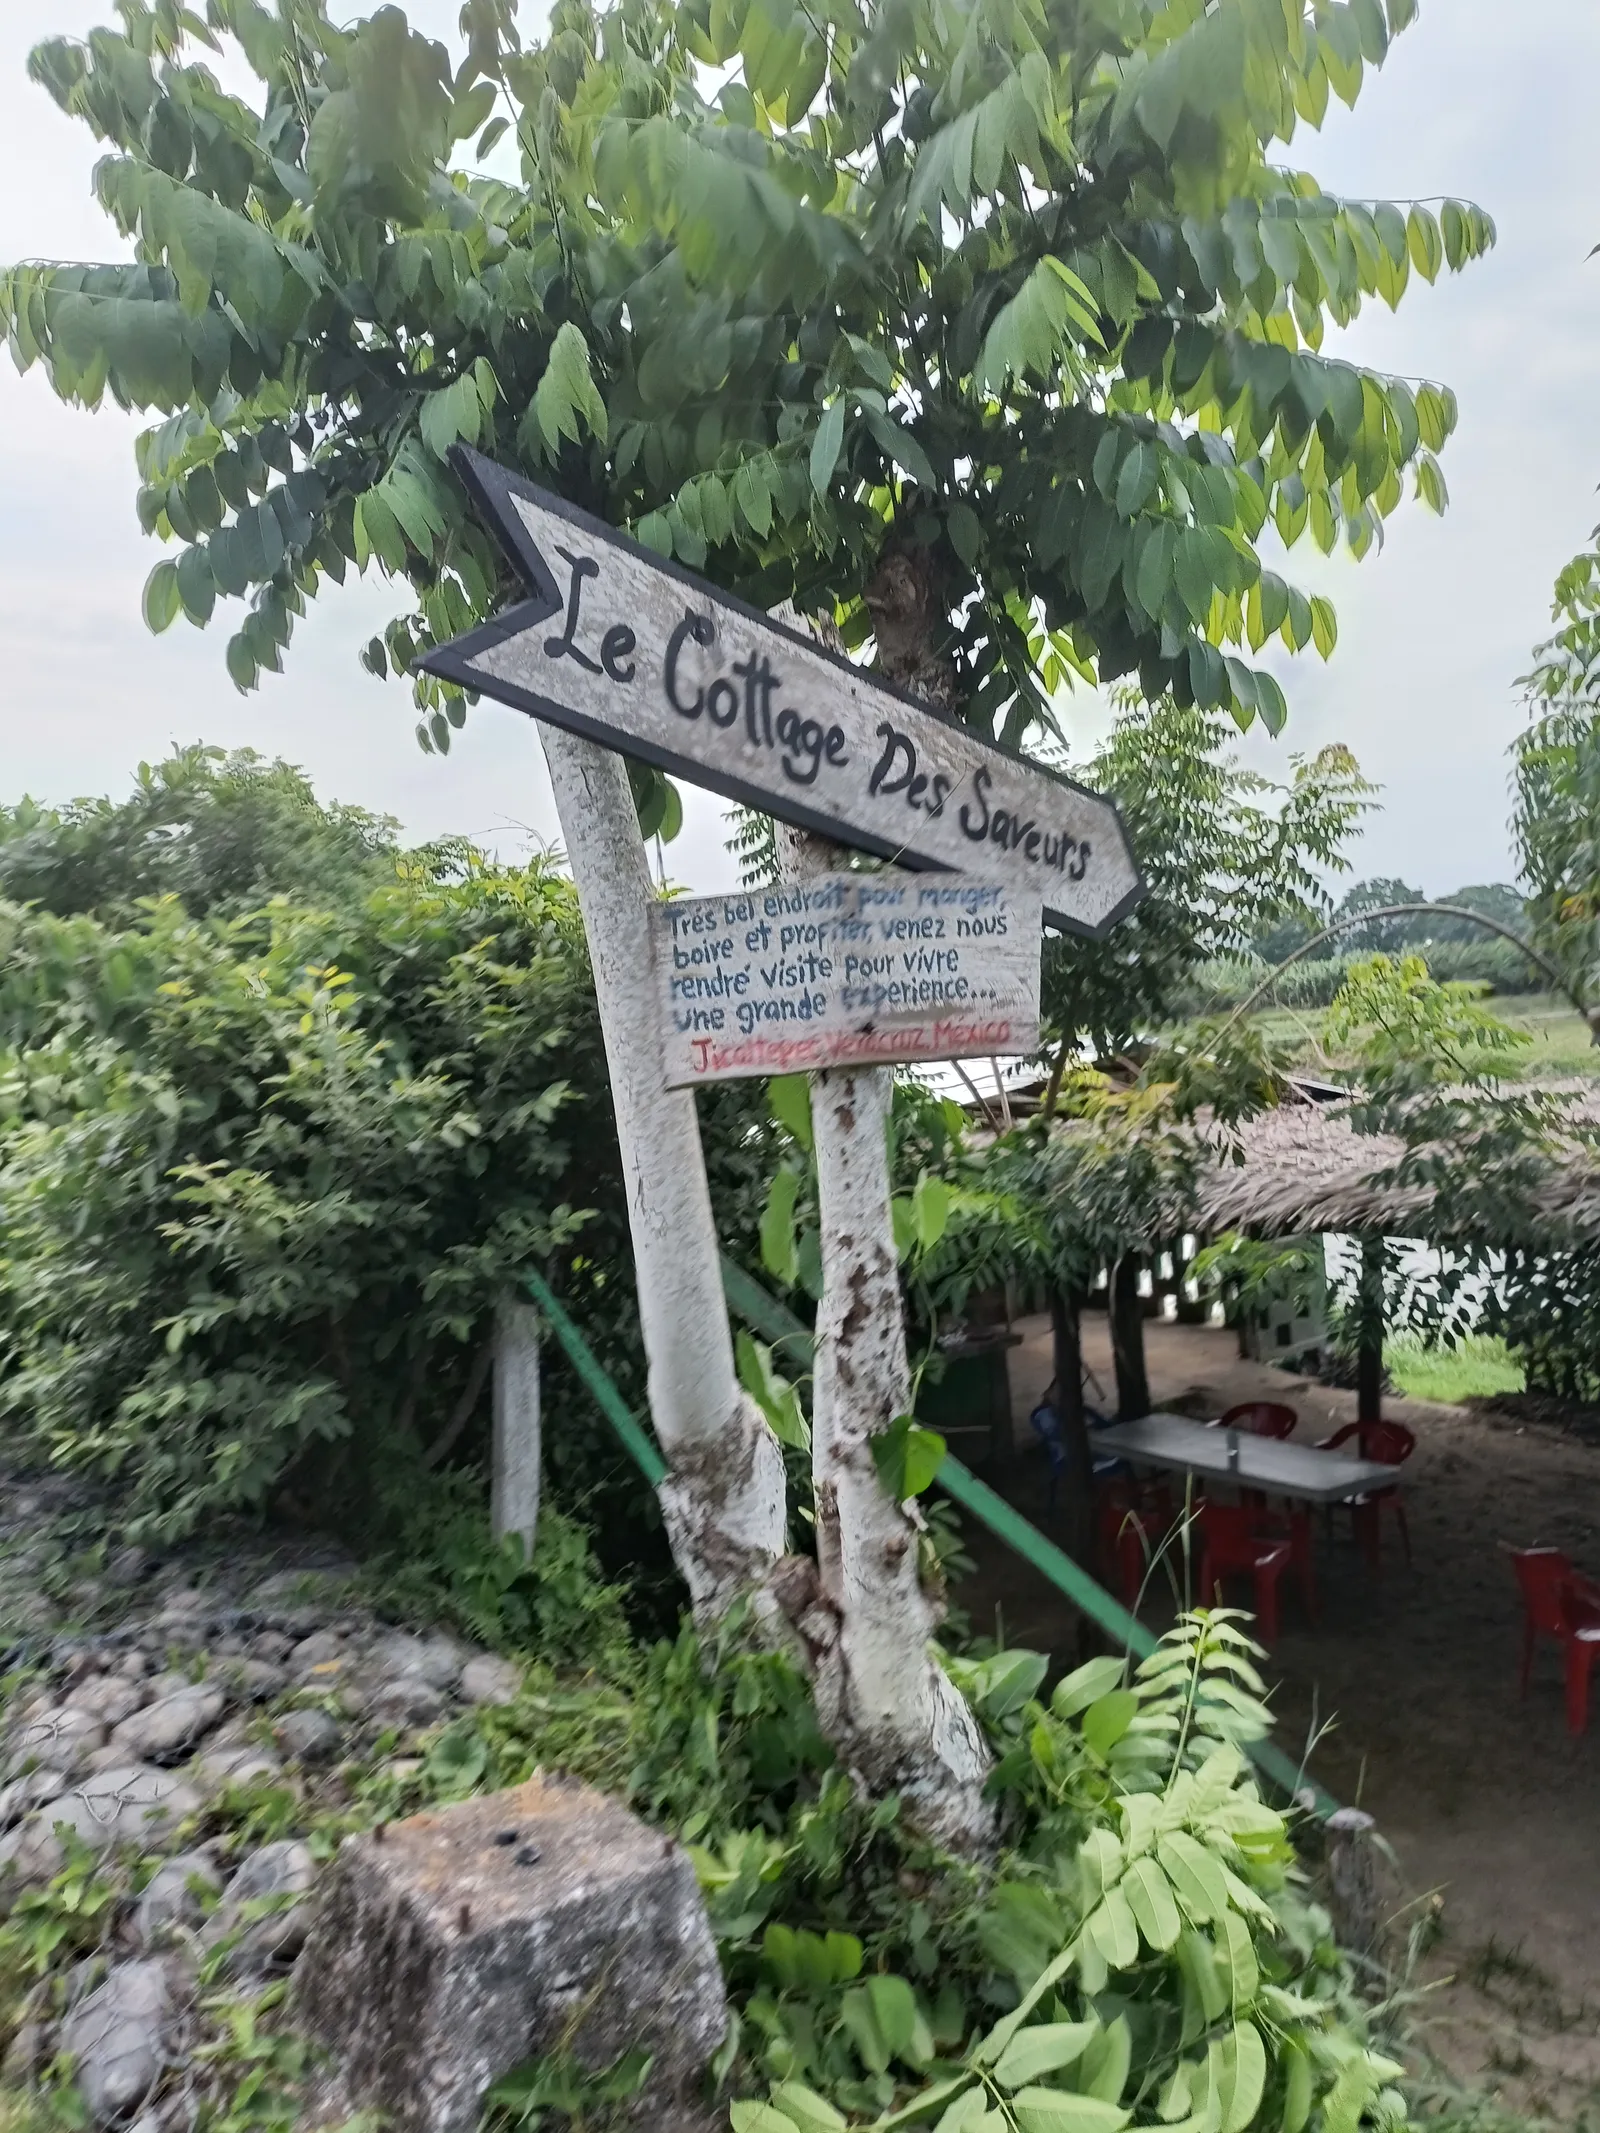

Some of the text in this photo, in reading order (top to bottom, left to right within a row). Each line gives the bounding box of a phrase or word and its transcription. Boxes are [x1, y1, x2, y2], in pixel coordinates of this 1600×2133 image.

[543, 544, 1091, 880] Le Cottage Des Saveurs
[724, 902, 755, 925] bel
[764, 877, 845, 917] endroit
[858, 887, 906, 912] pour
[673, 938, 734, 969] boire
[745, 919, 772, 951] et
[881, 916, 945, 941] venez
[956, 914, 1008, 938] nous
[760, 950, 833, 989] visite
[903, 946, 959, 974] vivre
[673, 1006, 725, 1032] une
[736, 987, 827, 1034] grande
